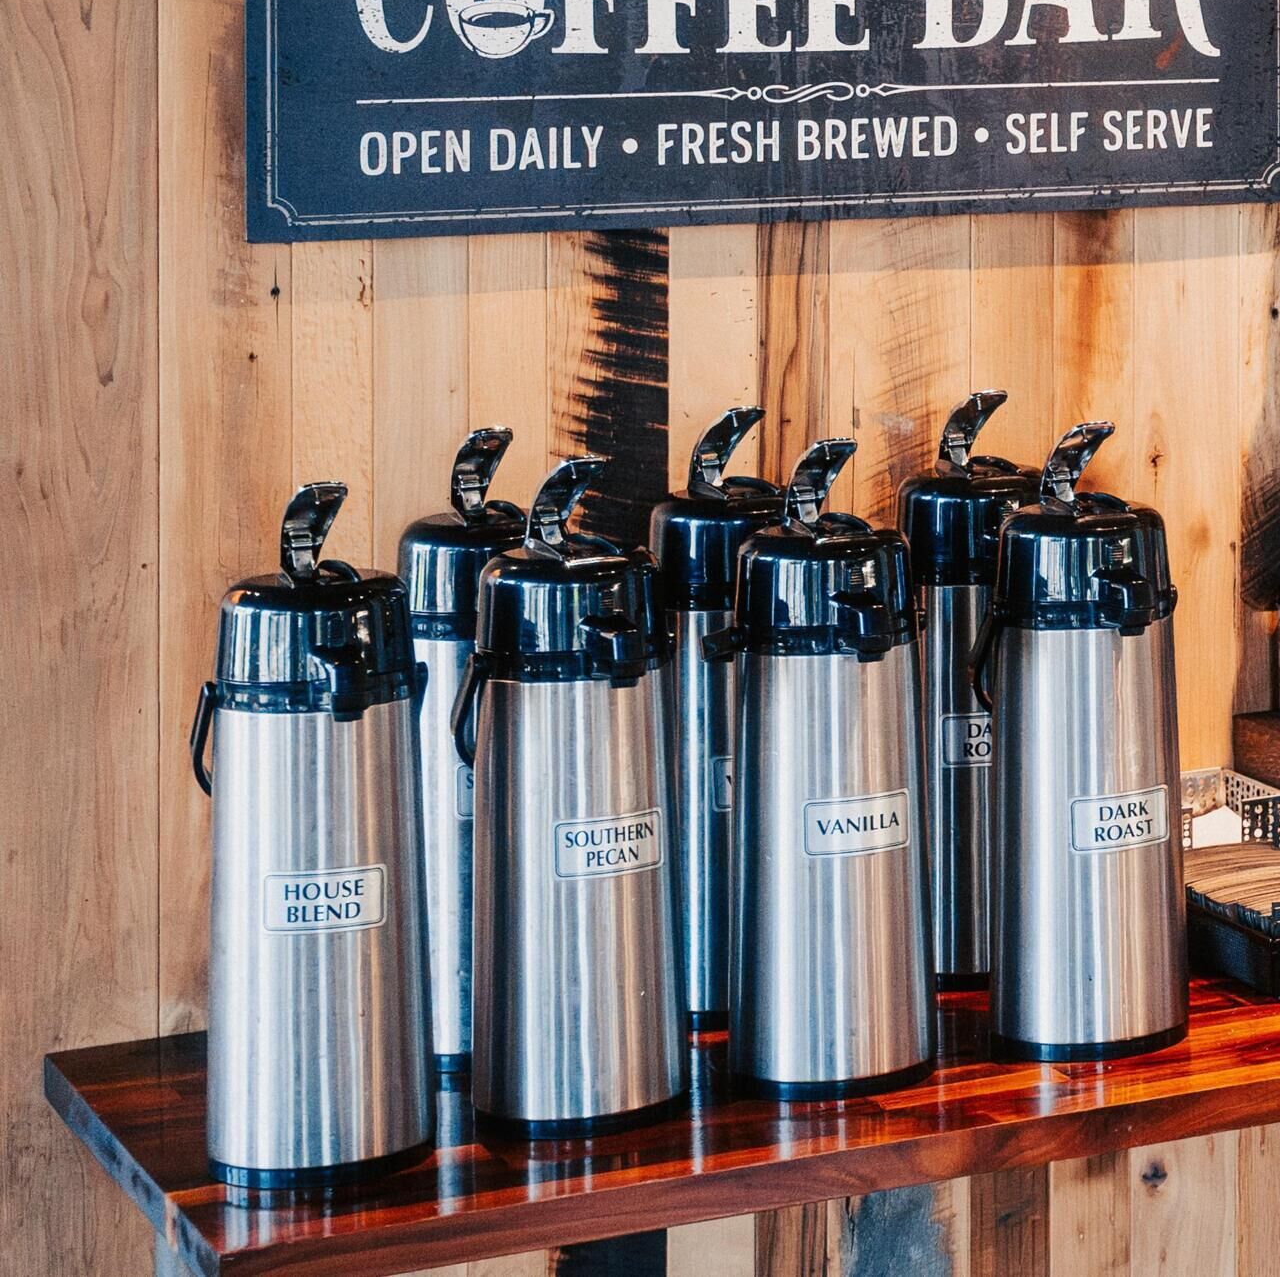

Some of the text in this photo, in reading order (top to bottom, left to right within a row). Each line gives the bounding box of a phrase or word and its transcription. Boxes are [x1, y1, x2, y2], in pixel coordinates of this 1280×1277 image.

[358, 106, 1214, 177] OPEN DAILY FRESH BREWED SELF SERVE
[967, 722, 993, 739] DA
[816, 810, 900, 836] VANILLA
[1098, 800, 1150, 823] DARK
[564, 820, 655, 850] SOUTHERN
[1093, 819, 1155, 844] ROAST
[585, 844, 641, 869] PECAN
[283, 878, 366, 902] HOUSE
[286, 900, 362, 924] BLEND
